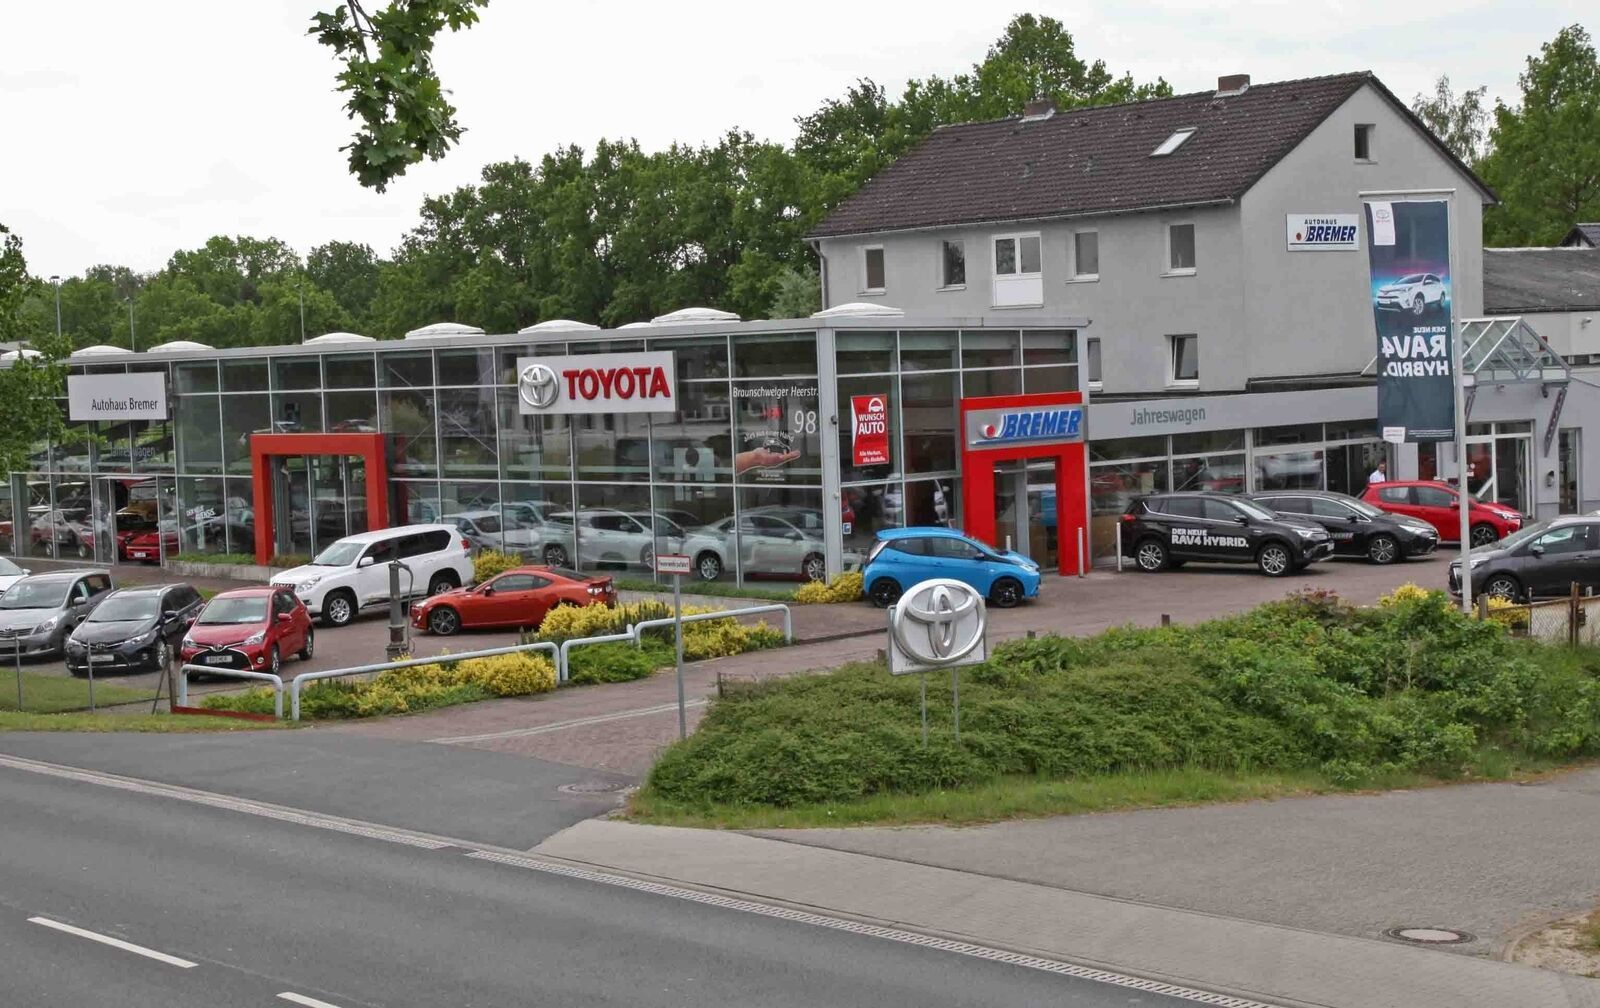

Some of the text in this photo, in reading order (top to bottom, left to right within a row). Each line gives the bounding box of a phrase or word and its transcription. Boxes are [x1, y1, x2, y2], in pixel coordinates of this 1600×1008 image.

[1305, 225, 1357, 242] BREMER
[562, 366, 671, 400] TOYOTA
[732, 386, 819, 399] Braunschweiger Heerstr.
[91, 397, 158, 411] Autohaus Bremer
[858, 413, 885, 422] WUNSCH
[1130, 402, 1206, 426] Jahreswagen
[794, 410, 816, 434] 98
[858, 421, 885, 435] AUTO
[1001, 408, 1083, 438] BREMER
[1171, 528, 1208, 537] DER NEUE
[1171, 535, 1250, 548] RAV4 HYBRID.
